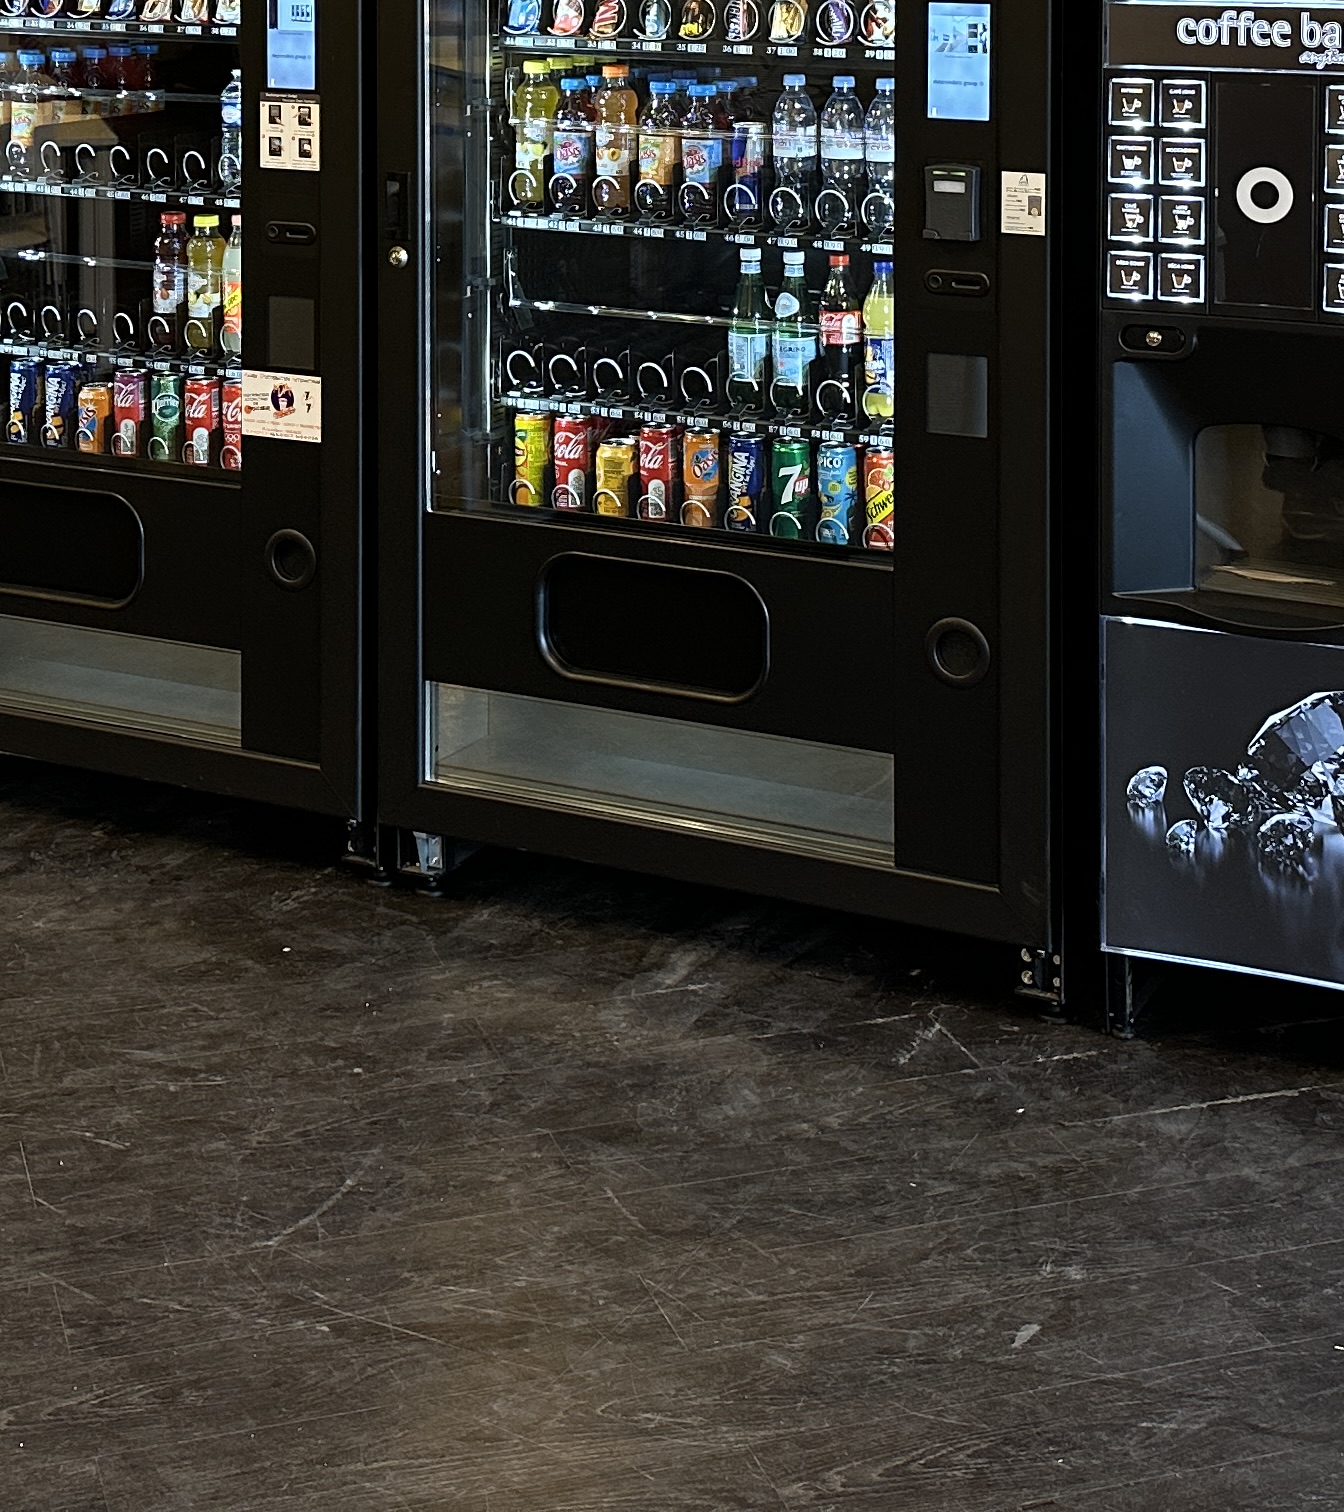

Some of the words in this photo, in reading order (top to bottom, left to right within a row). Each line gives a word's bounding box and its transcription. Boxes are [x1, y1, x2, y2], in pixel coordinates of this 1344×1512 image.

[1176, 10, 1292, 47] coffee
[778, 464, 803, 505] 7
[794, 477, 809, 495] up
